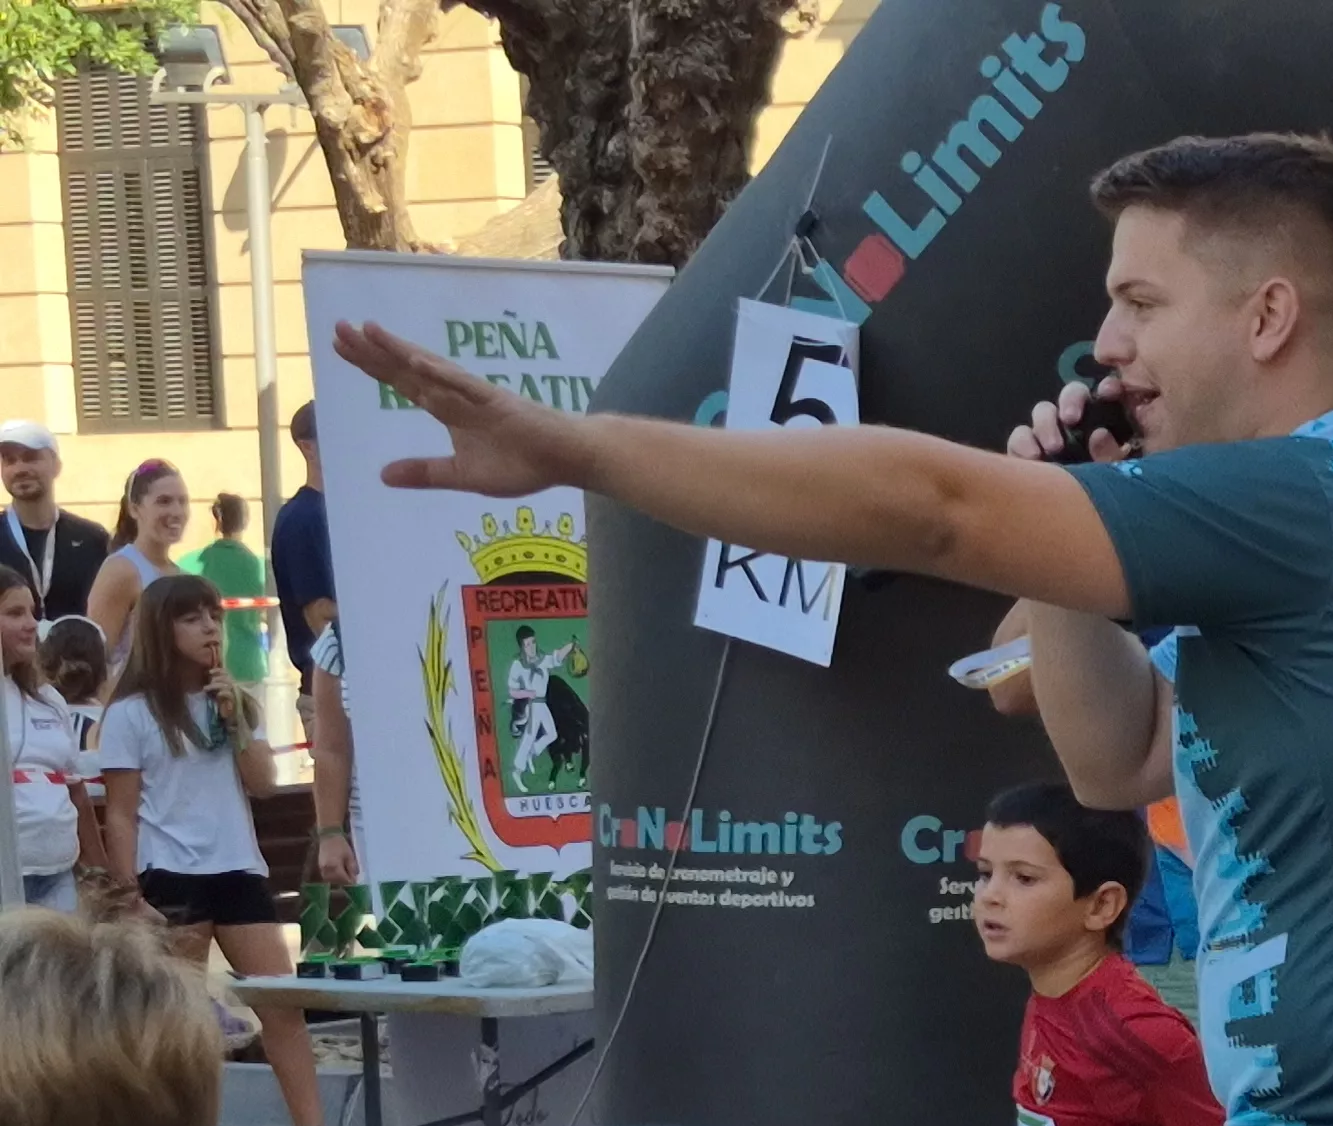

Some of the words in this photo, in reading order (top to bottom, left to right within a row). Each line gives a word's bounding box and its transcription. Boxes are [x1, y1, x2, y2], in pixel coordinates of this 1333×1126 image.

[444, 309, 561, 360] PEÑA
[770, 334, 850, 426] 5
[714, 541, 839, 621] KM
[719, 888, 815, 909] deportivos
